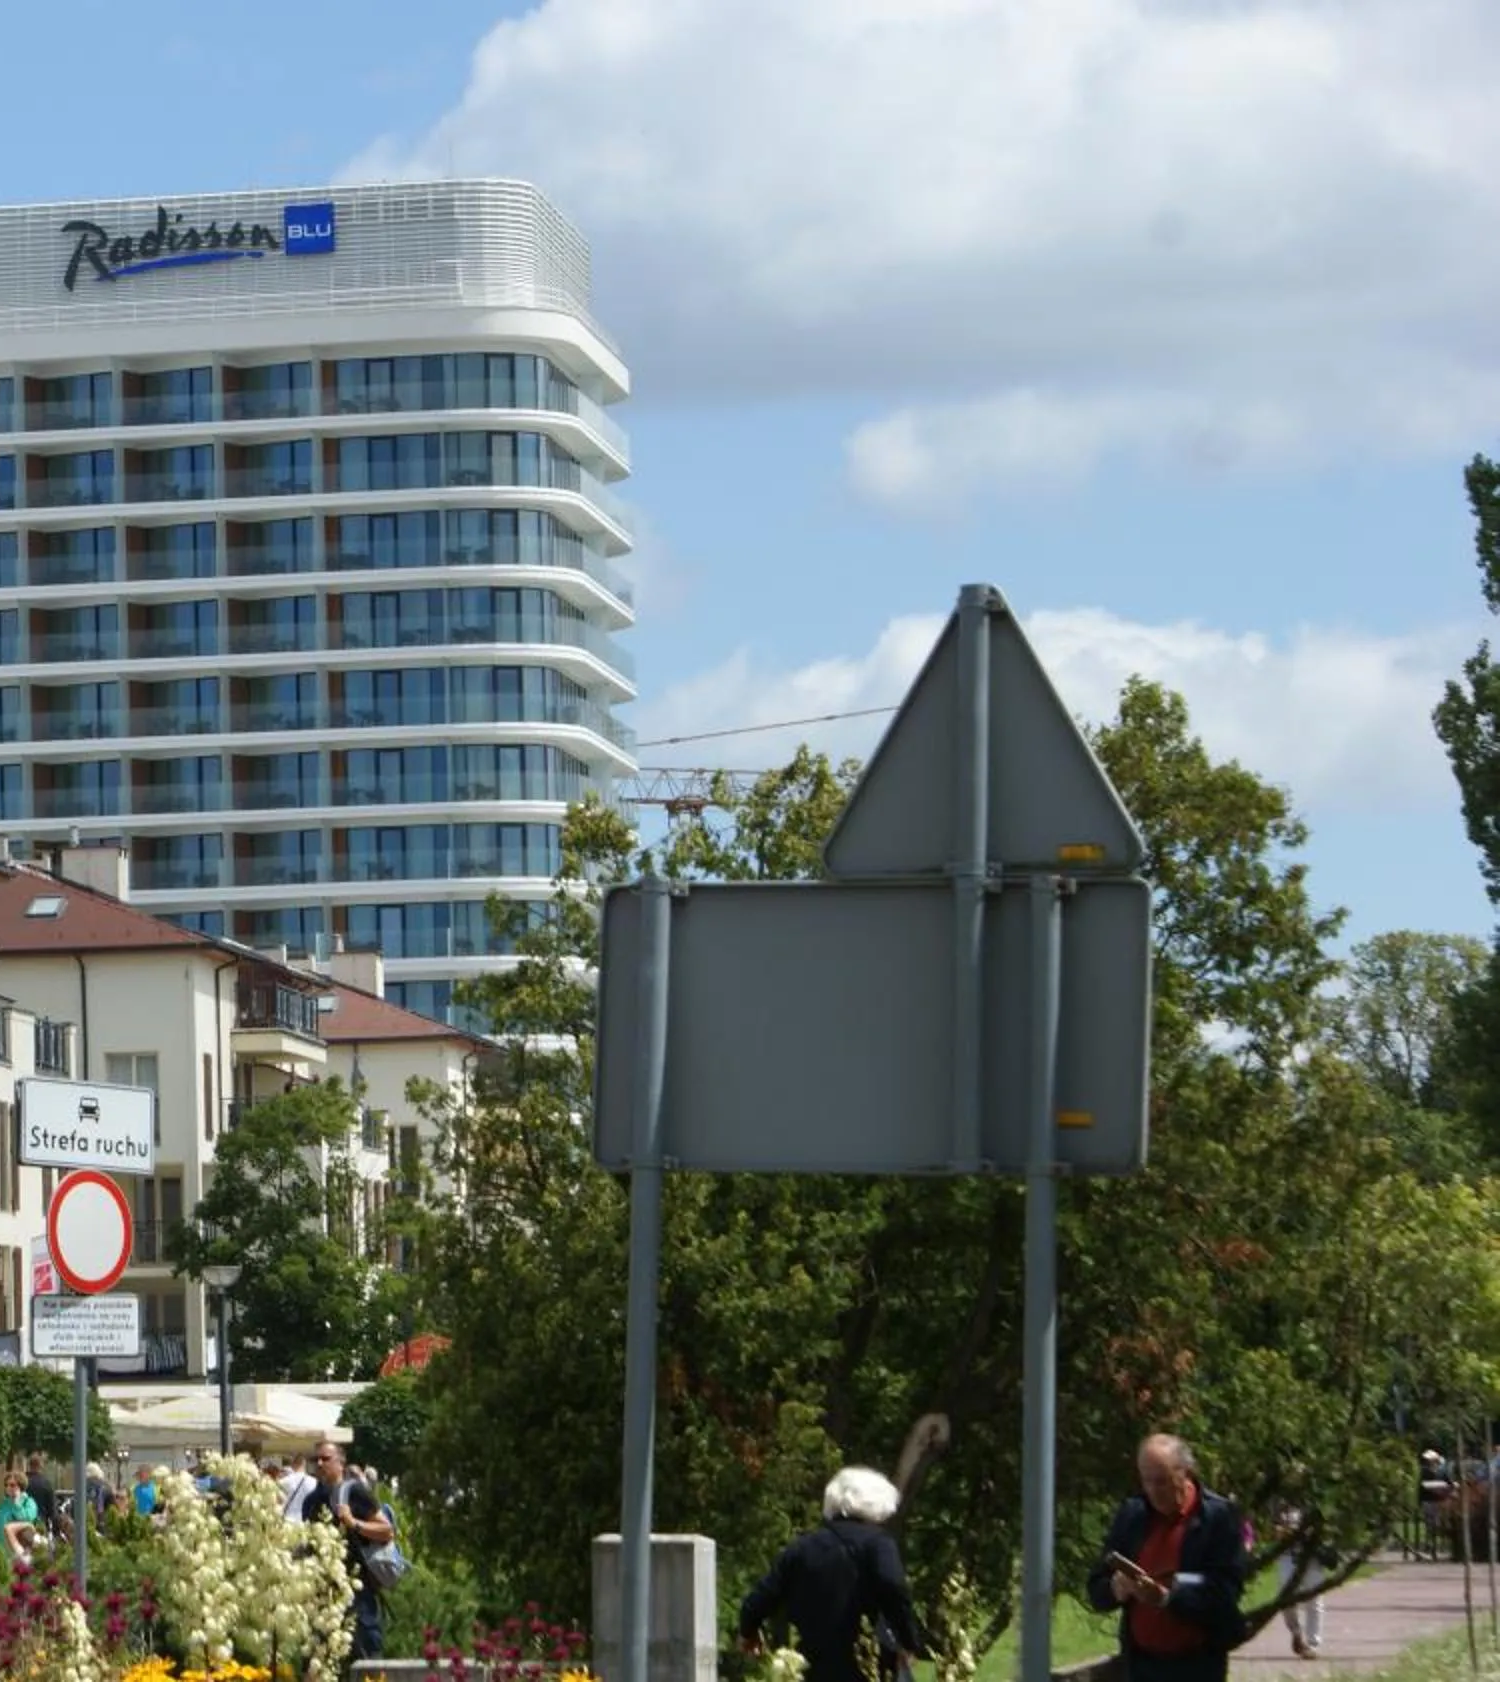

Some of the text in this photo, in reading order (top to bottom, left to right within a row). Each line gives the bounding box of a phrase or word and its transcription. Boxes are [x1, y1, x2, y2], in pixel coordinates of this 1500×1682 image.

[60, 205, 332, 292] Radisson BLU
[29, 1125, 149, 1158] Strefa ruchu
